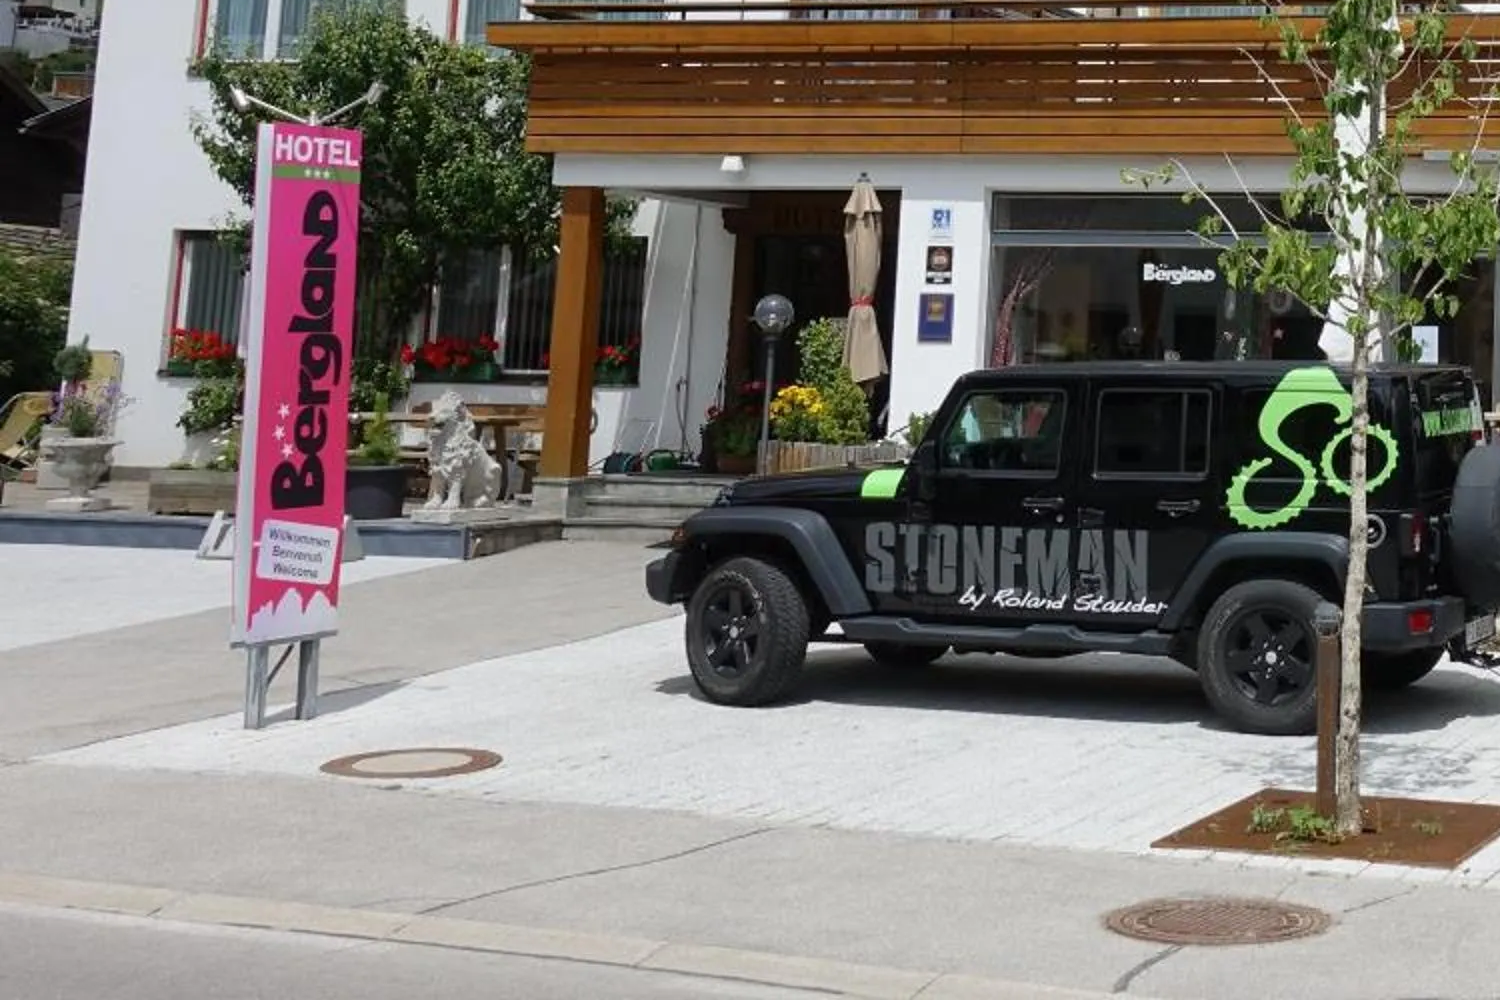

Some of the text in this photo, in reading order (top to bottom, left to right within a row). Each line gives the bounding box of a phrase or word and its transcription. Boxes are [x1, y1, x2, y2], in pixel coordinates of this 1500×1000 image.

[275, 133, 360, 167] HOTEL
[269, 527, 331, 548] Willkommen
[864, 521, 1149, 602] STONEMAN
[958, 585, 1169, 614] by Roland Stauder
